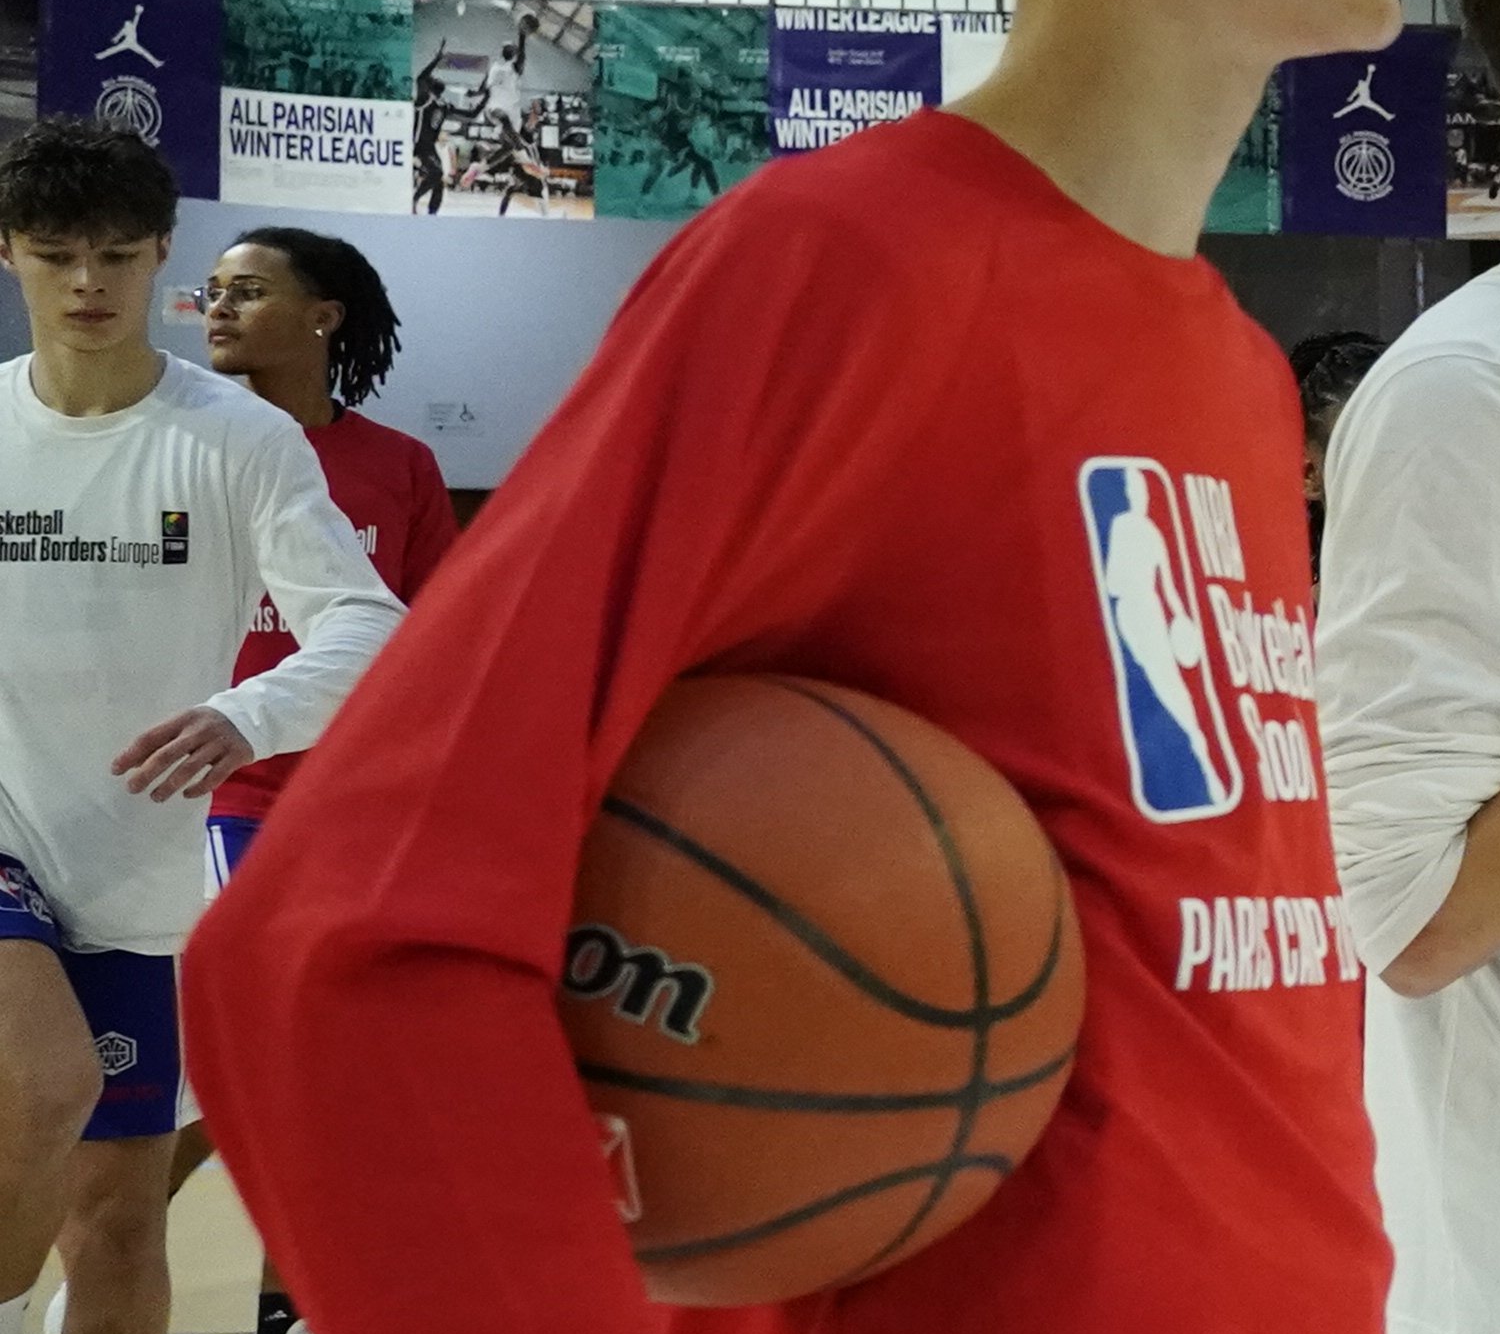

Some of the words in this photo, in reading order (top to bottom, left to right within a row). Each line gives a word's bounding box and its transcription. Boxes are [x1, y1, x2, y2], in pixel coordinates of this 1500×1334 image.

[230, 97, 268, 127] ALL
[273, 102, 375, 136] PARISIAN
[788, 87, 829, 118] ALL
[830, 88, 923, 121] PARISIAN
[230, 128, 314, 162] WINTER
[318, 137, 404, 167] LEAGUE
[40, 535, 107, 563] Borders
[111, 536, 160, 568] Europe
